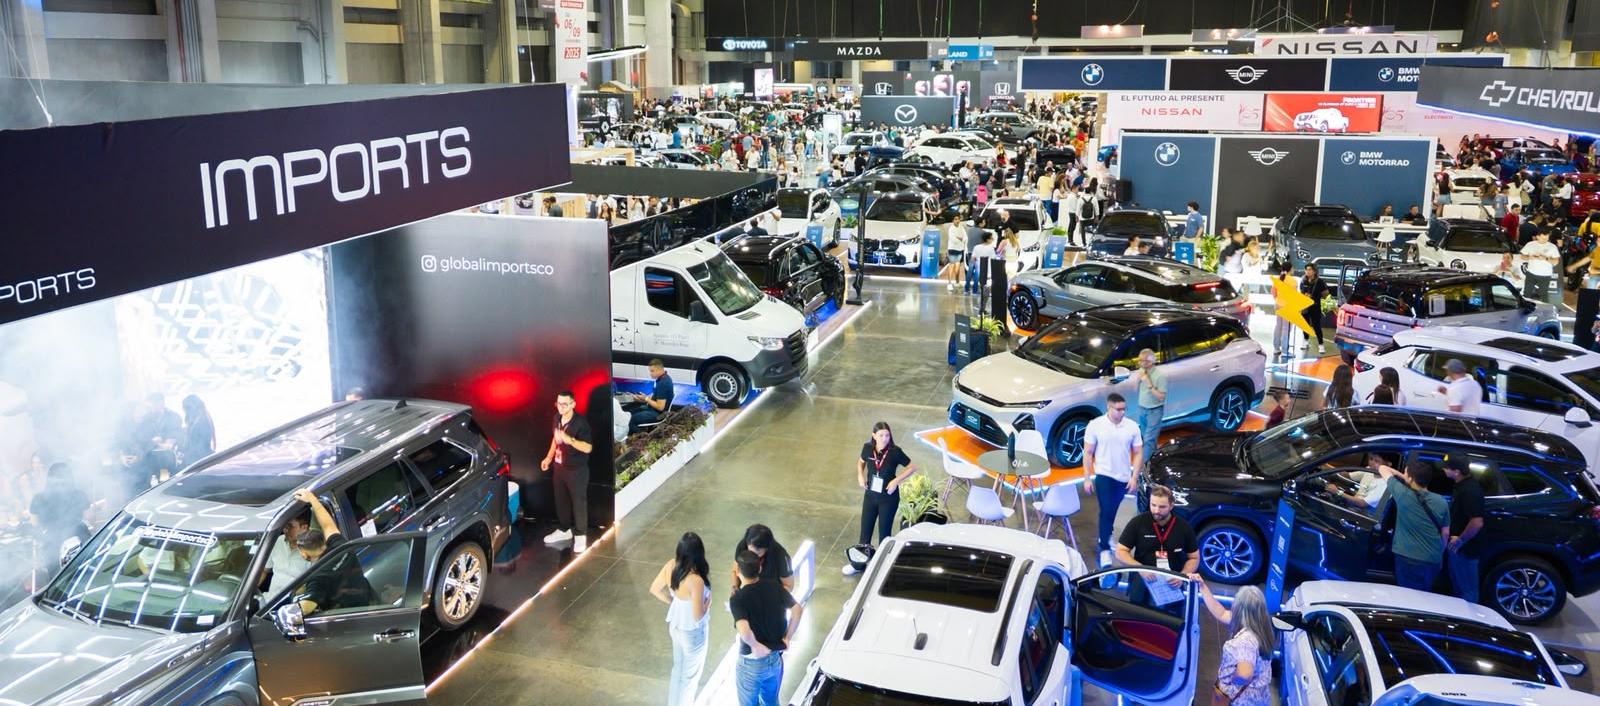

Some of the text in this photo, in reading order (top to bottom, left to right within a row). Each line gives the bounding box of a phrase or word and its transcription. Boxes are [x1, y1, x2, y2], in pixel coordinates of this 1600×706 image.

[736, 40, 767, 49] TOYOTA
[1278, 40, 1417, 55] NISSAN
[565, 48, 579, 58] 2025
[837, 47, 882, 56] MAZDA
[1517, 87, 1600, 113] CHEVROL
[1141, 108, 1203, 116] NISSAN
[1359, 151, 1383, 159] BMW
[200, 126, 472, 229] IMPORTS
[440, 256, 554, 276] globalimportsco
[0, 267, 96, 304] PORTS
